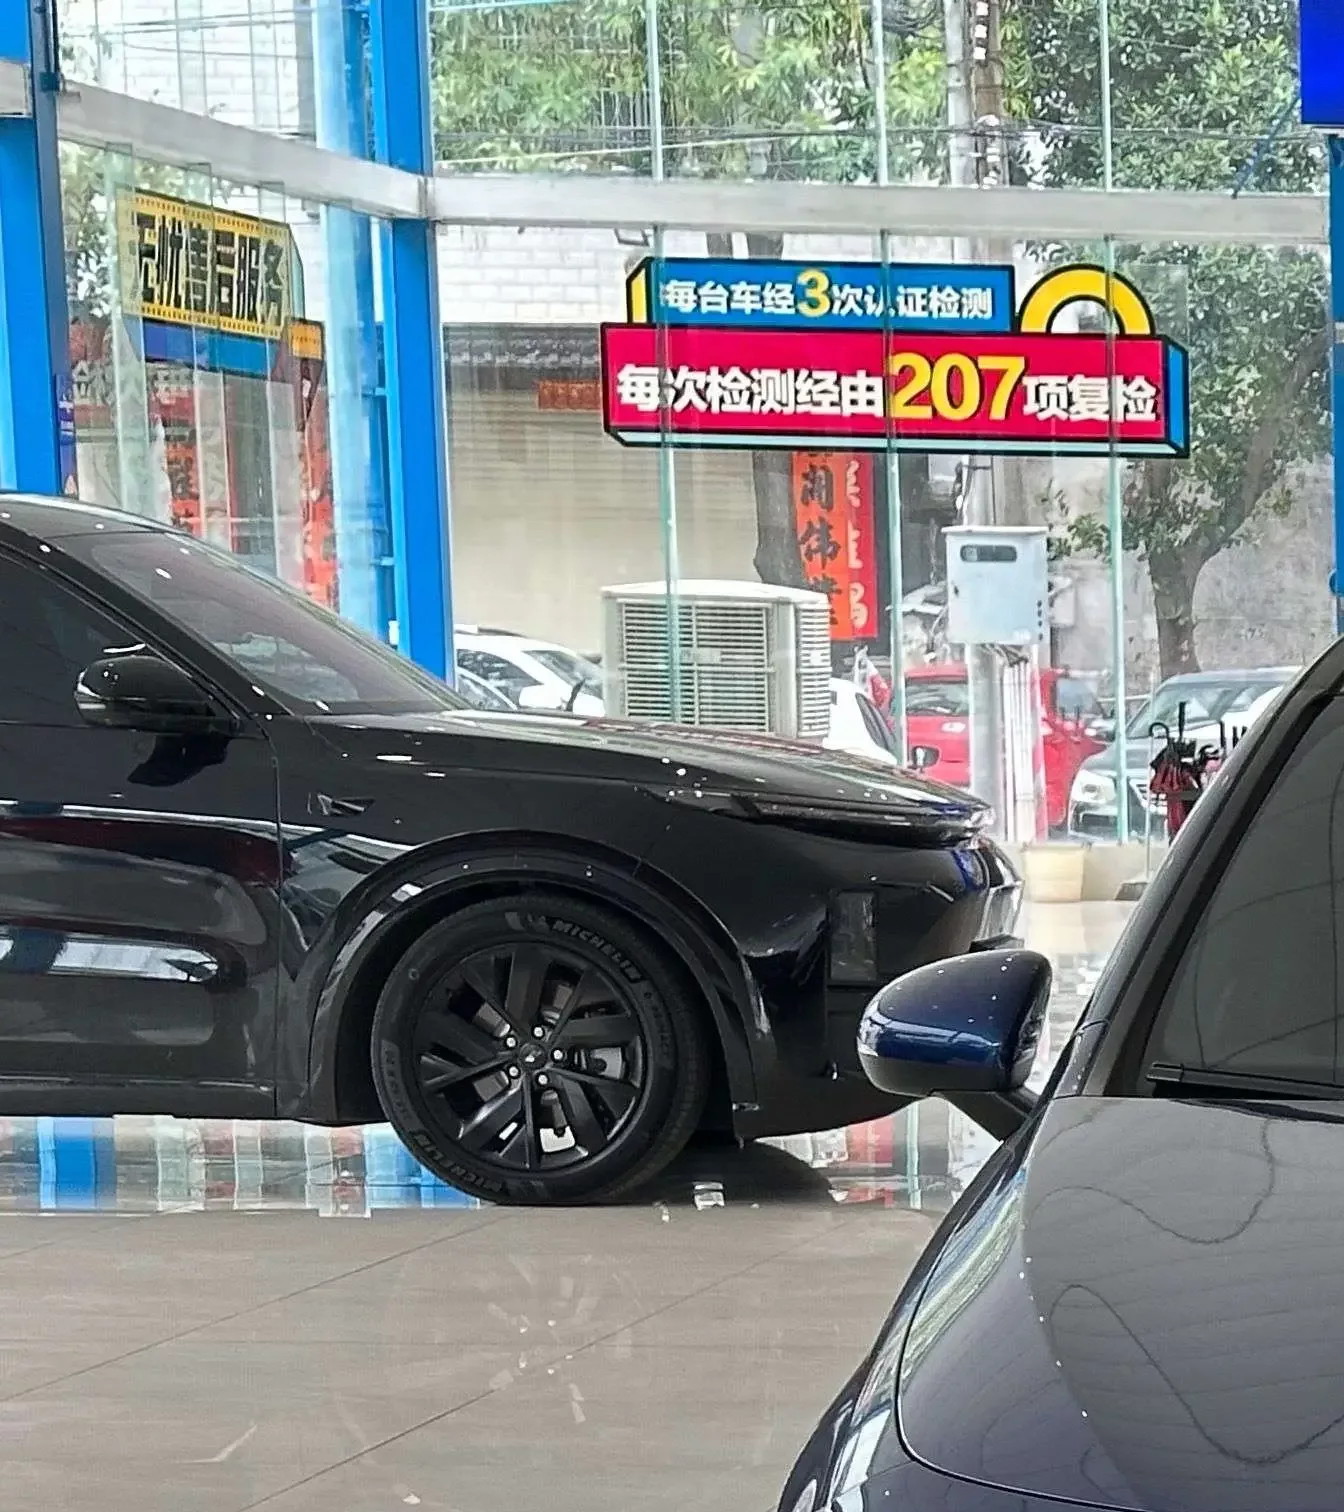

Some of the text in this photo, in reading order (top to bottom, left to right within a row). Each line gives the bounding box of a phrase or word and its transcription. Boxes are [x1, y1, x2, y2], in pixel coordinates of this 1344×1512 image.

[127, 212, 287, 330] 无忧售后服务
[616, 352, 1159, 423] 每次检测经由207项复检
[551, 917, 646, 983] MICHELIN
